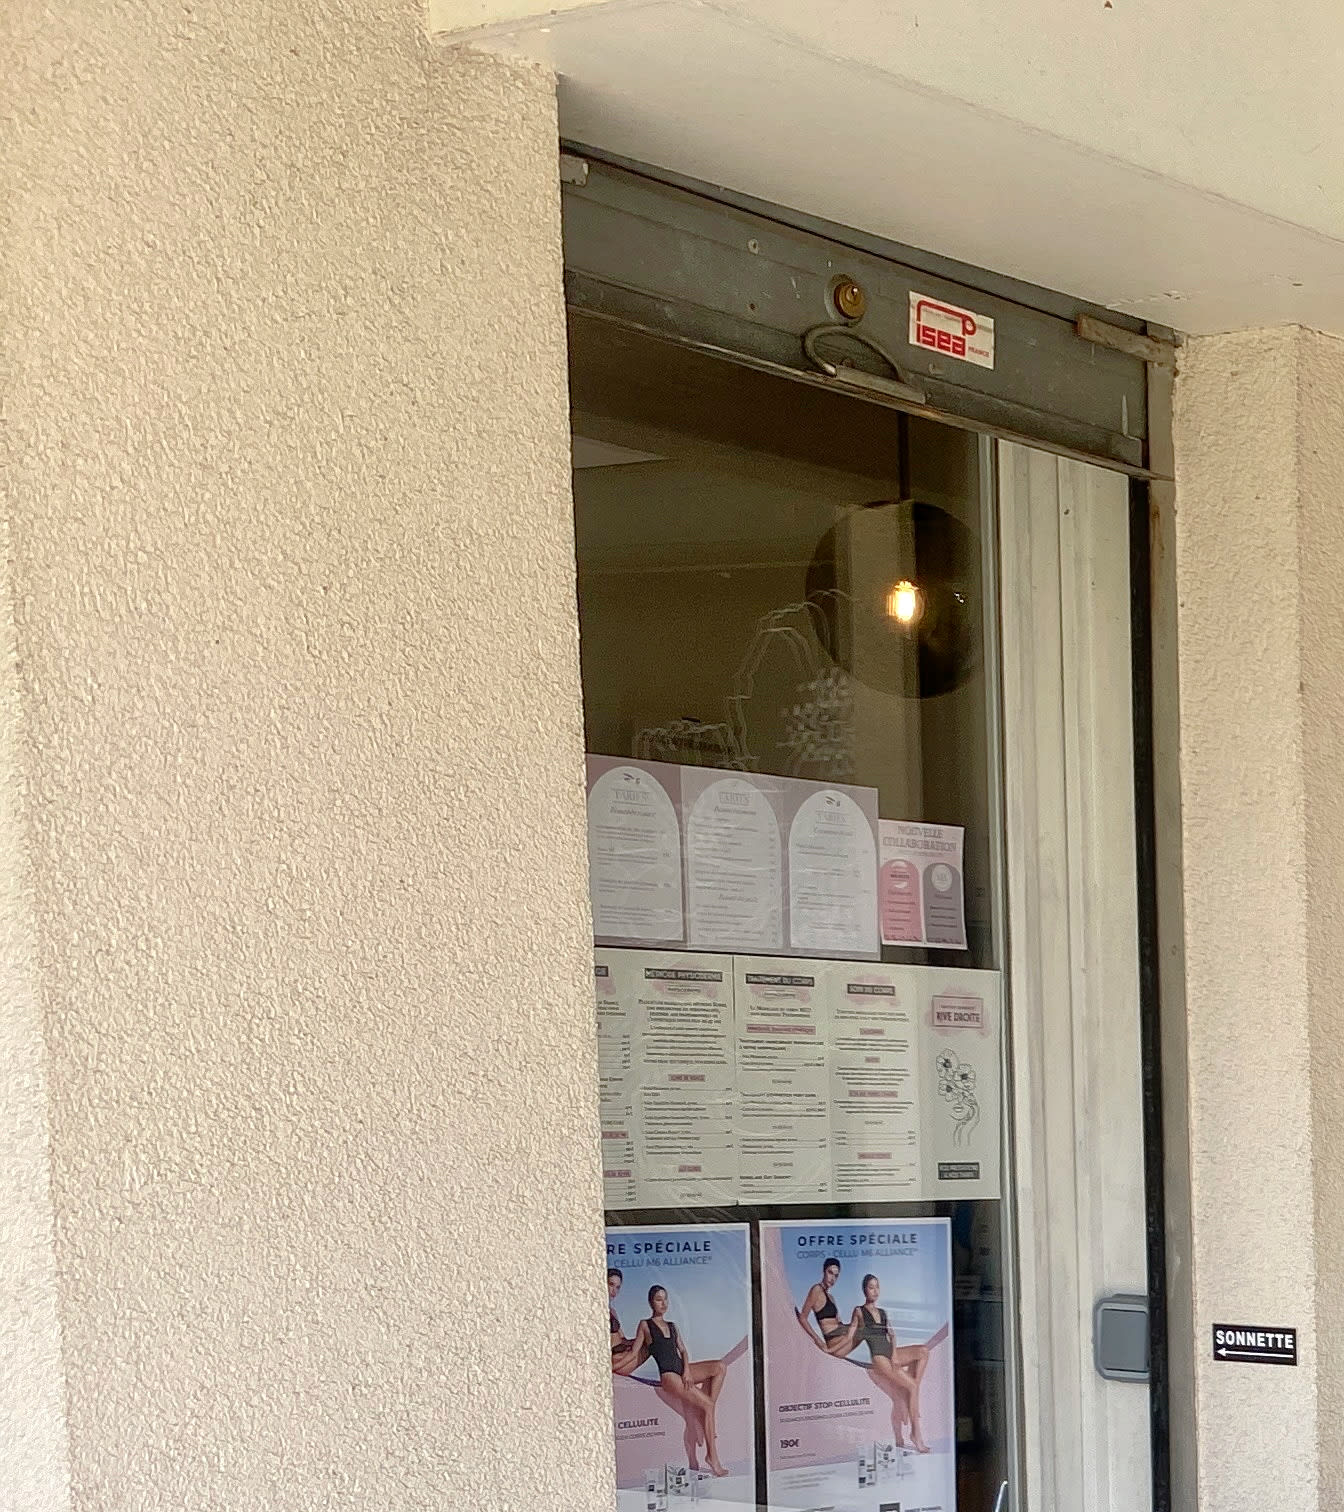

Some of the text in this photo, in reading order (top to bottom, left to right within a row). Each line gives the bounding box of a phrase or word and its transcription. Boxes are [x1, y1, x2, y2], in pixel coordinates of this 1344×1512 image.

[633, 1238, 712, 1255] SPÉCIALE
[797, 1231, 918, 1248] OFFRE SPÉCIALE
[1215, 1330, 1294, 1349] SONNETTE
[814, 1401, 833, 1410] STOP
[618, 1418, 659, 1430] CELLULITE
